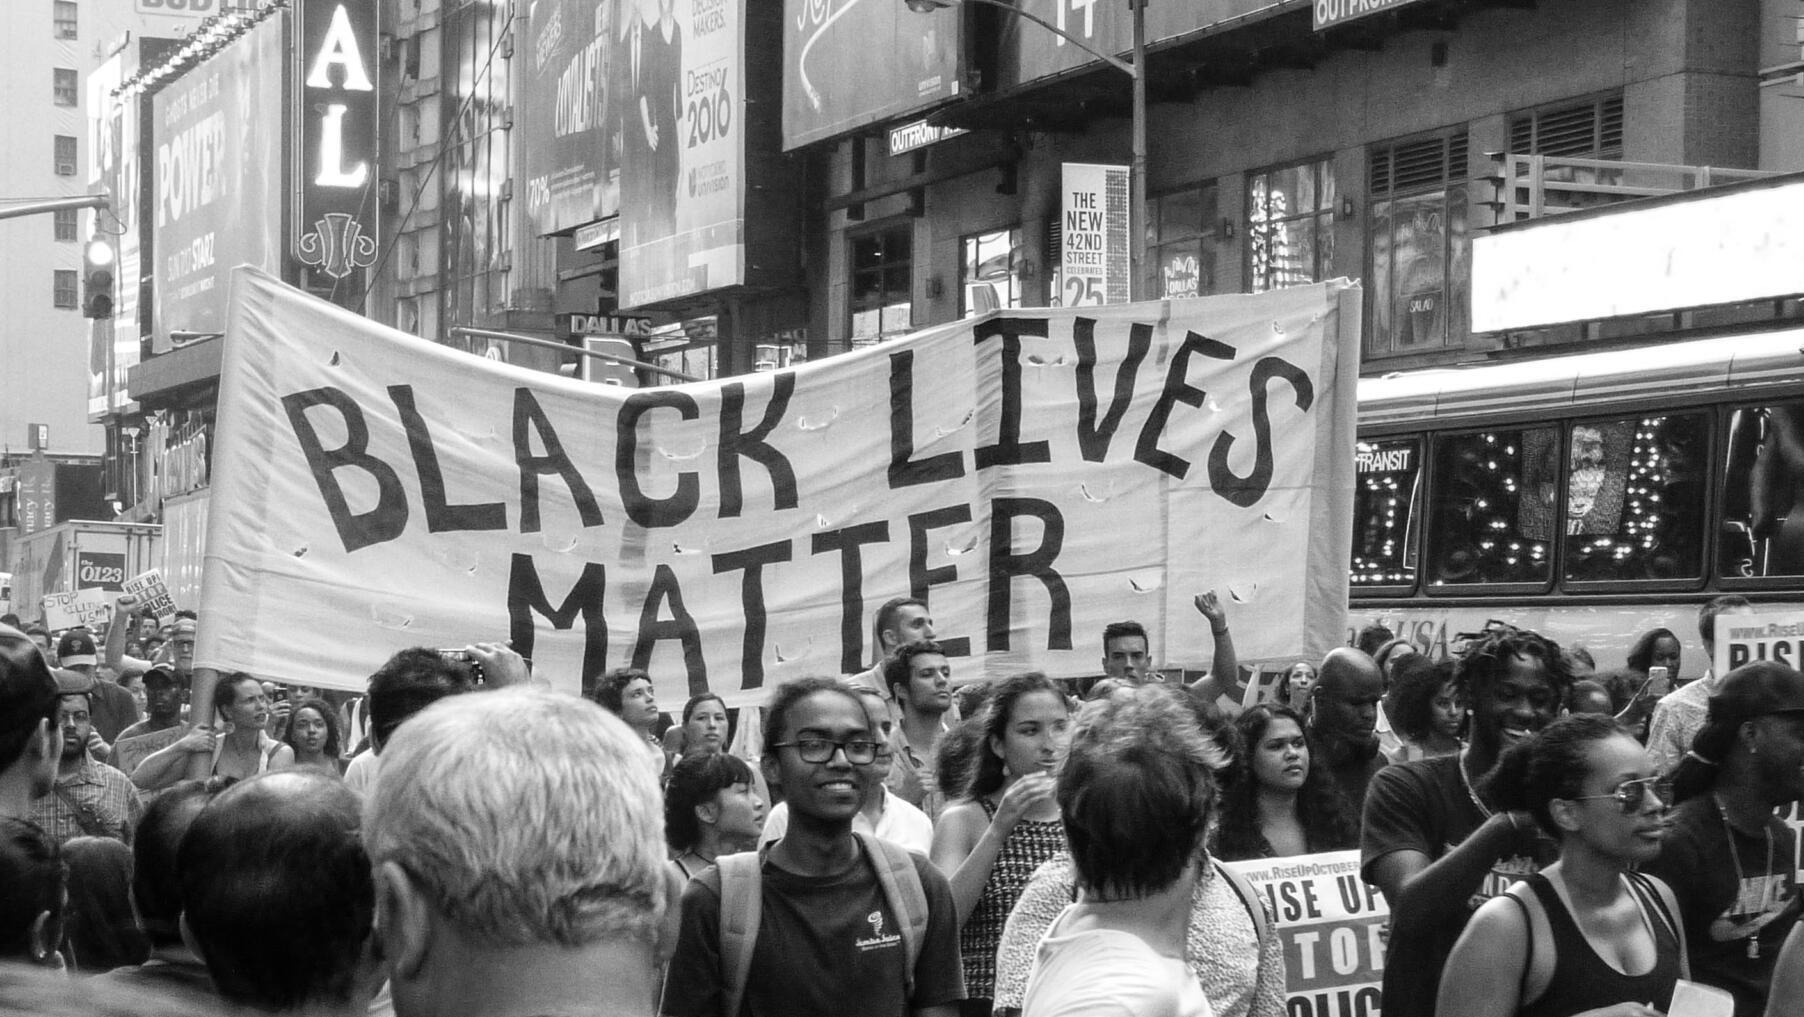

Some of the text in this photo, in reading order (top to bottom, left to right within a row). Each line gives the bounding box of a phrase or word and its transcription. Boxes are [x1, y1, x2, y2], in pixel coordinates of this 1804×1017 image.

[687, 67, 731, 149] 2016
[158, 110, 227, 228] POWER
[529, 174, 550, 209] 70%
[1072, 192, 1097, 209] THE
[1066, 210, 1103, 232] NEW
[192, 231, 215, 272] STARZ
[1066, 233, 1102, 251] 42ND
[1065, 251, 1104, 265] STREET
[1065, 266, 1104, 275] CELEBRATES
[1065, 276, 1104, 307] 25
[1409, 298, 1434, 313] SALAD
[570, 315, 651, 336] DALLAS
[281, 316, 1314, 552] BLACK LIVES
[1357, 449, 1411, 473] TRANSIT
[46, 591, 79, 608] STOP
[125, 580, 144, 595] RISE
[508, 497, 1073, 700] MATTER
[143, 593, 174, 611] OLICE
[1729, 640, 1804, 672] RIS
[1266, 880, 1322, 923] ISE
[1293, 923, 1386, 980] TOP
